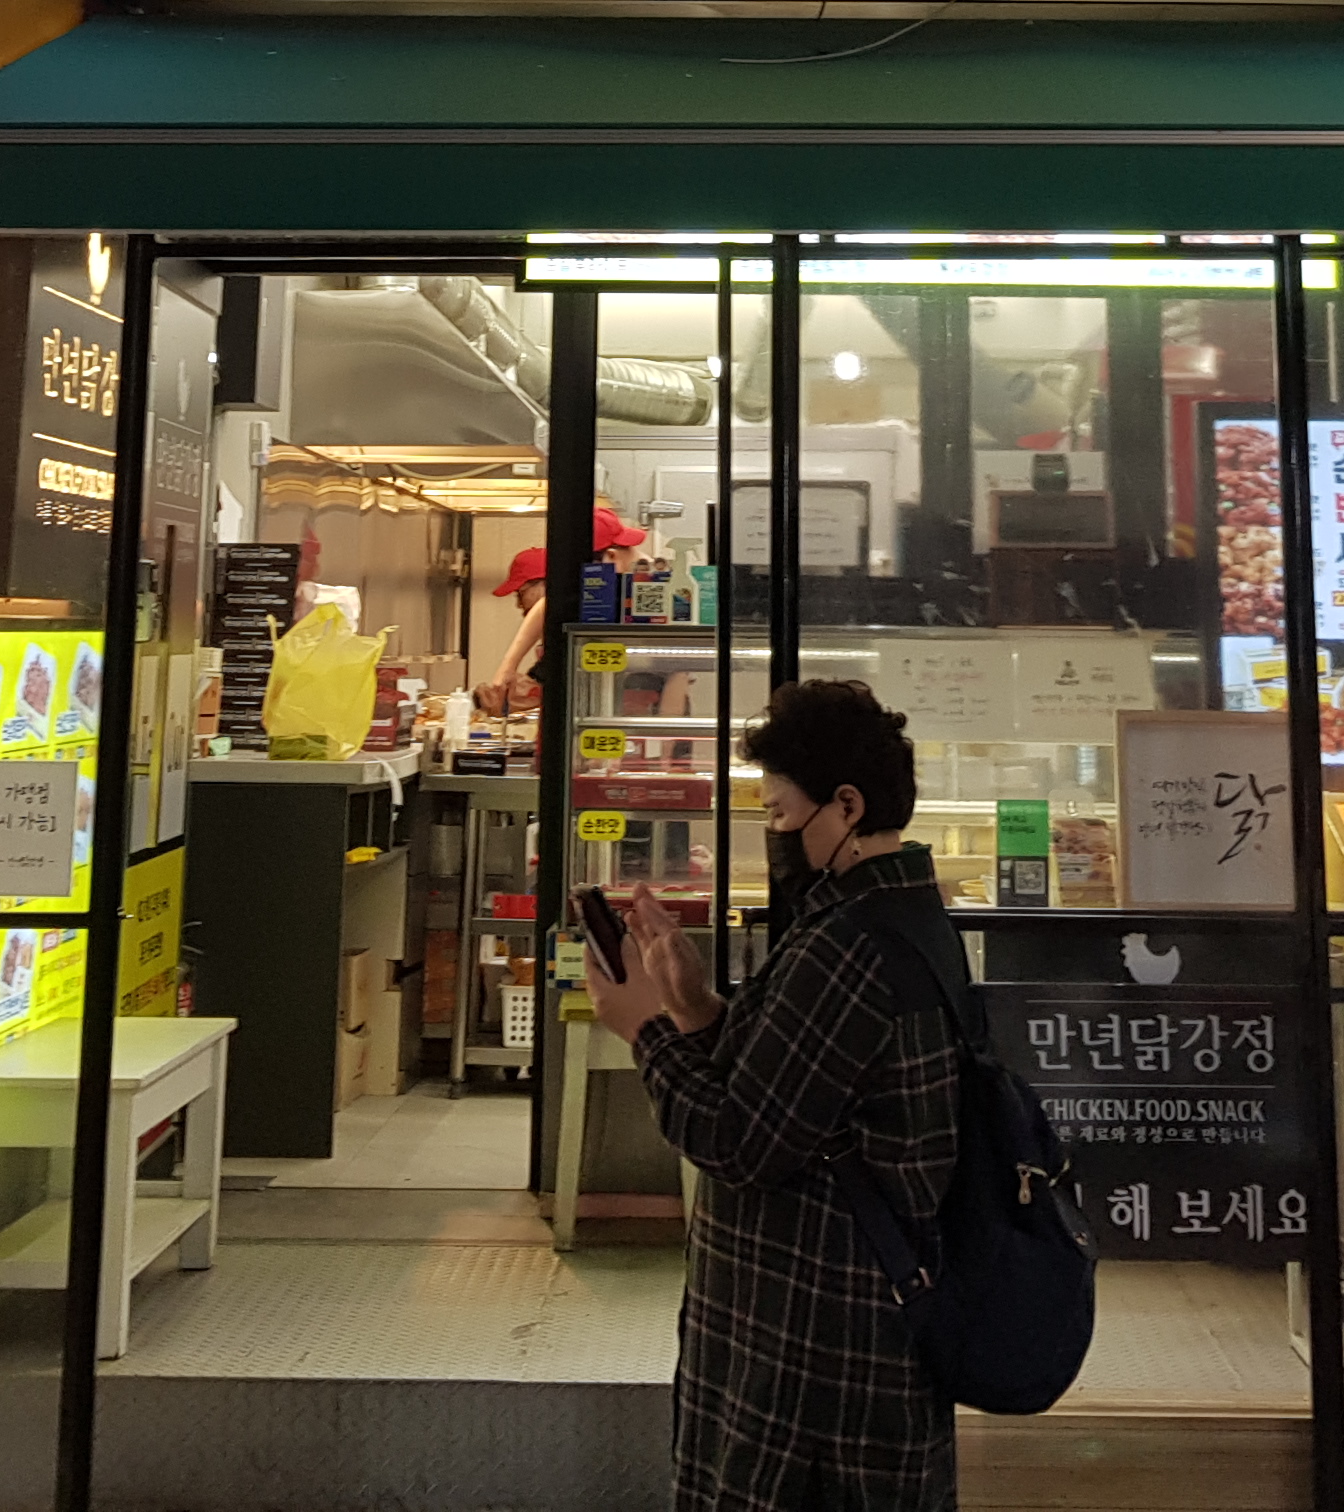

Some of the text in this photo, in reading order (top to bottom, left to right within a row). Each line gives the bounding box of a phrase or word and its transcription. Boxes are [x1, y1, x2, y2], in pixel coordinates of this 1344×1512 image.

[1026, 1013, 1276, 1073] 만년닭강정
[1131, 1125, 1198, 1144] 정성으로
[1171, 1183, 1307, 1242] 보세요
